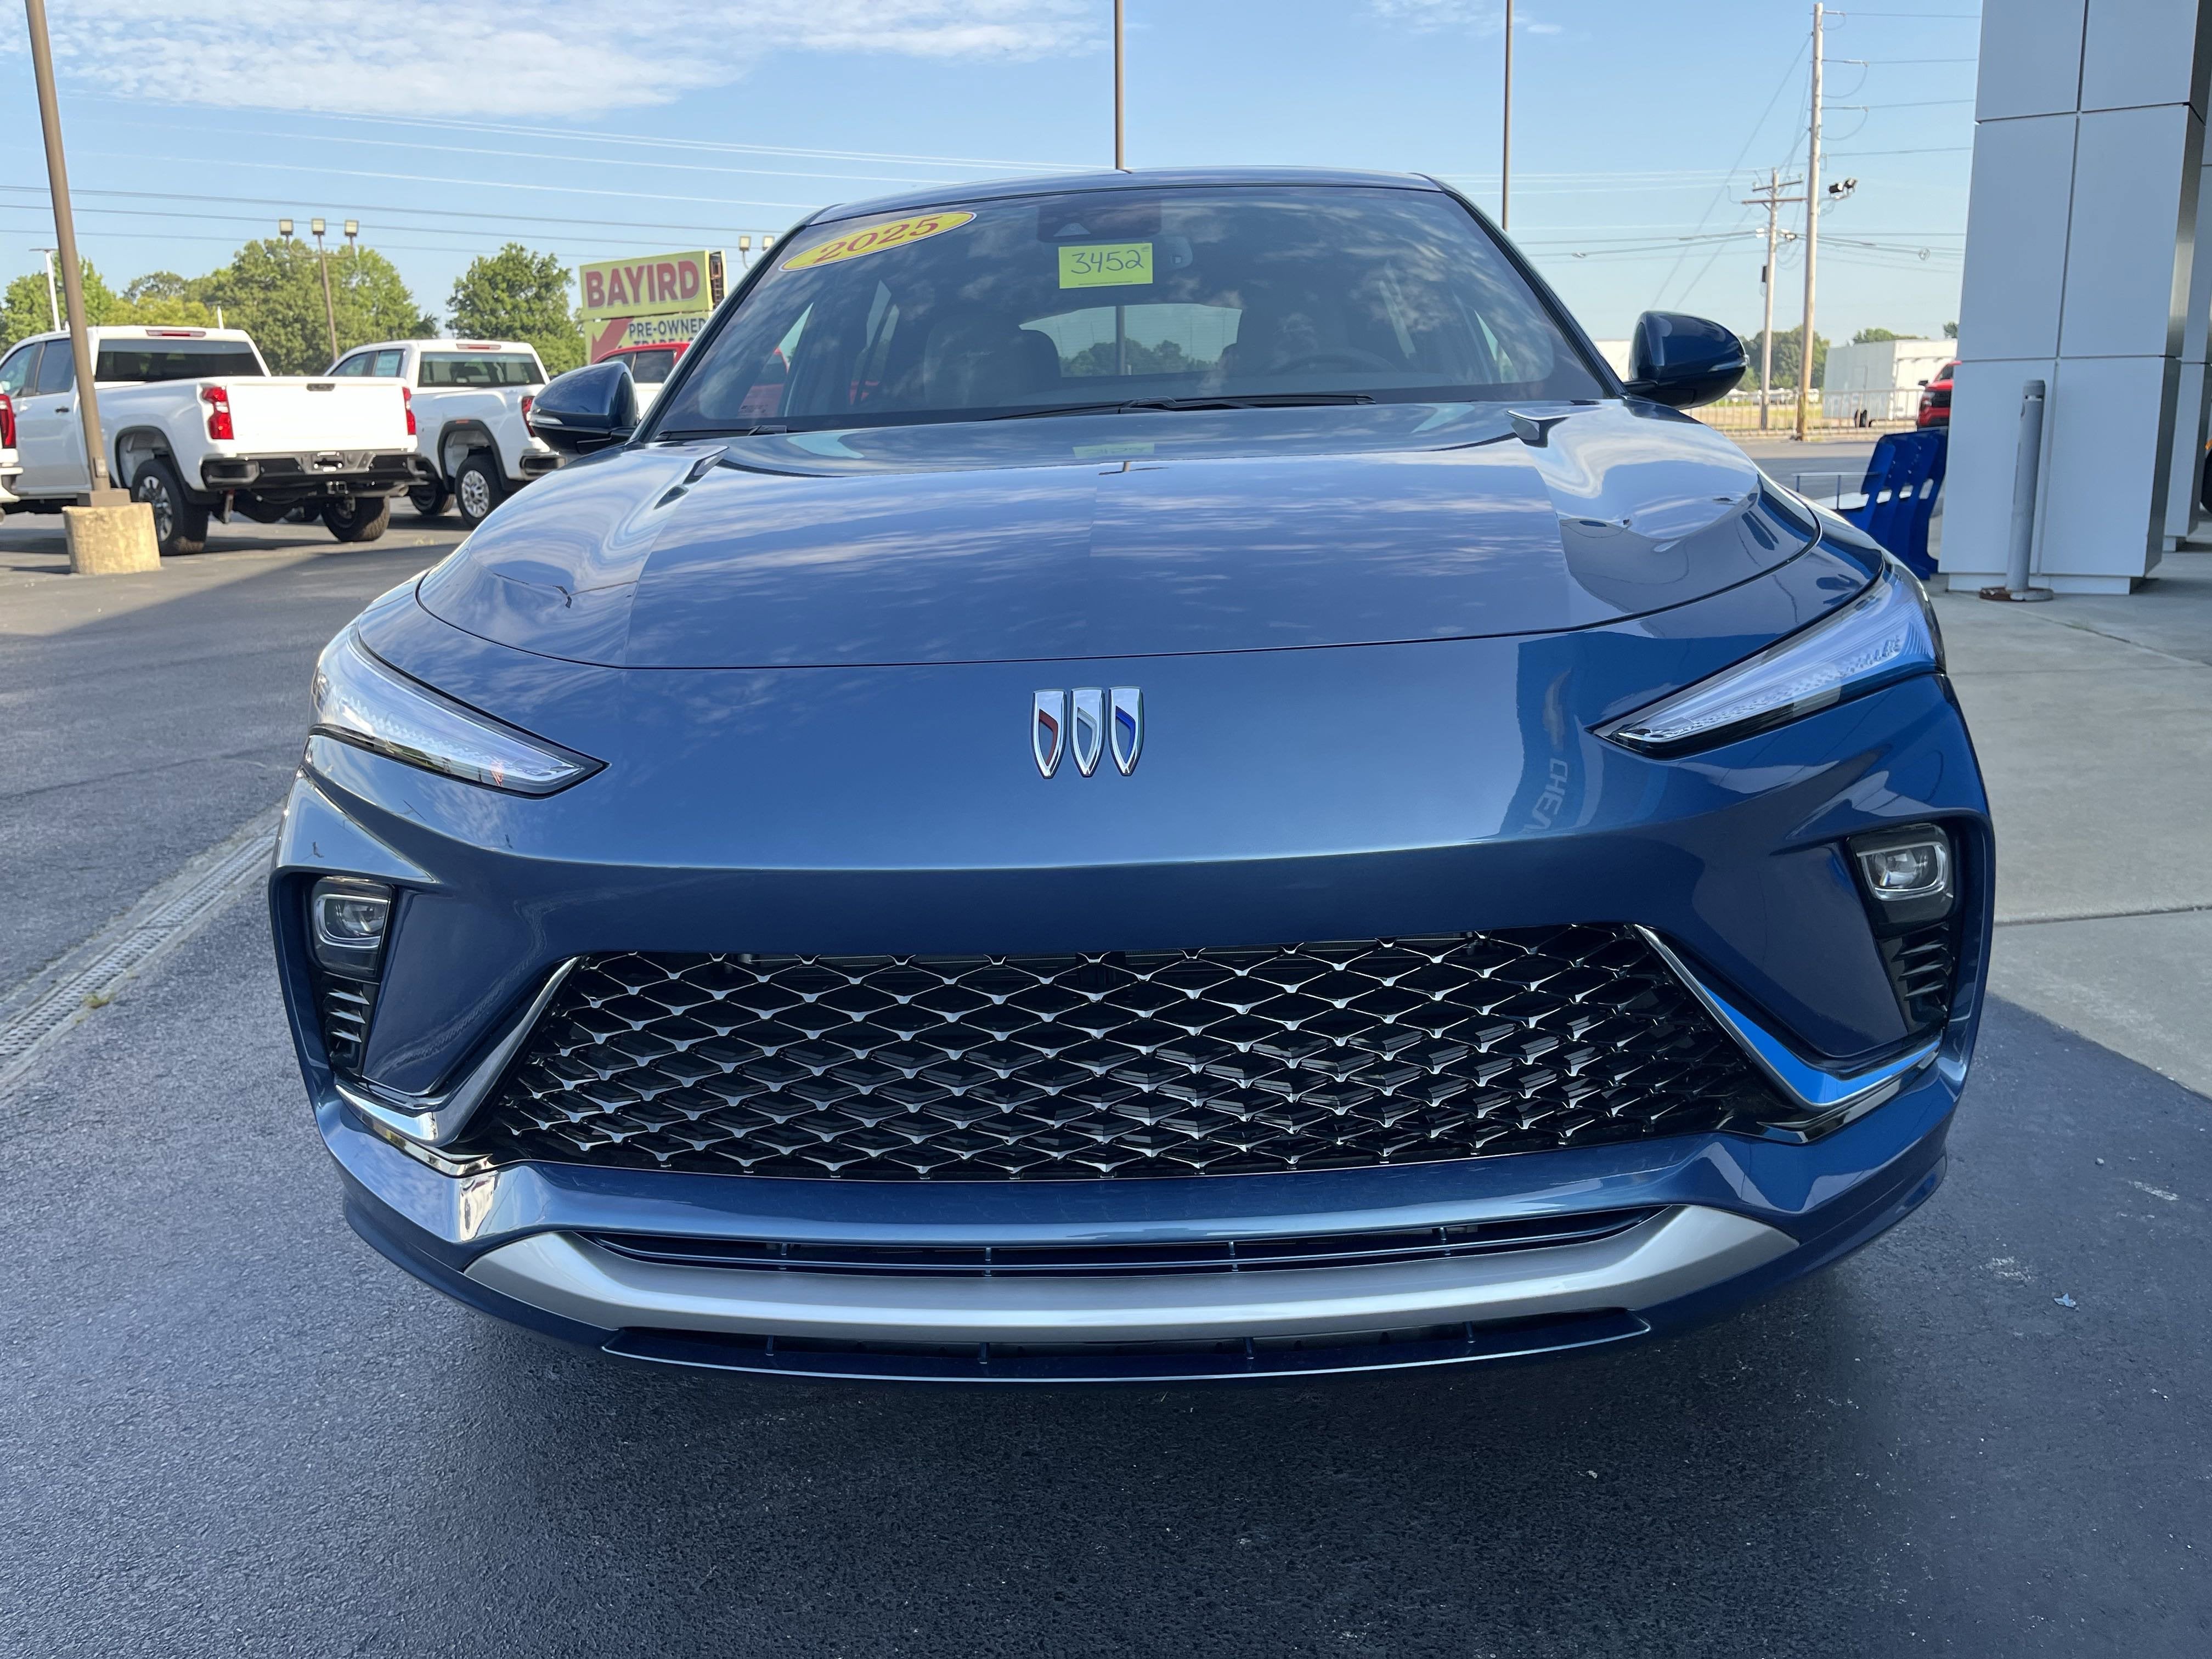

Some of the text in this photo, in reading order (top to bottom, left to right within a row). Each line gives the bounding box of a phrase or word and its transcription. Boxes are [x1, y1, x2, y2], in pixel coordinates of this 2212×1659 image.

[814, 216, 943, 263] 2025
[1071, 250, 1144, 274] 3452
[585, 260, 699, 309] BAYIRD
[629, 318, 706, 338] PRE-OWNED
